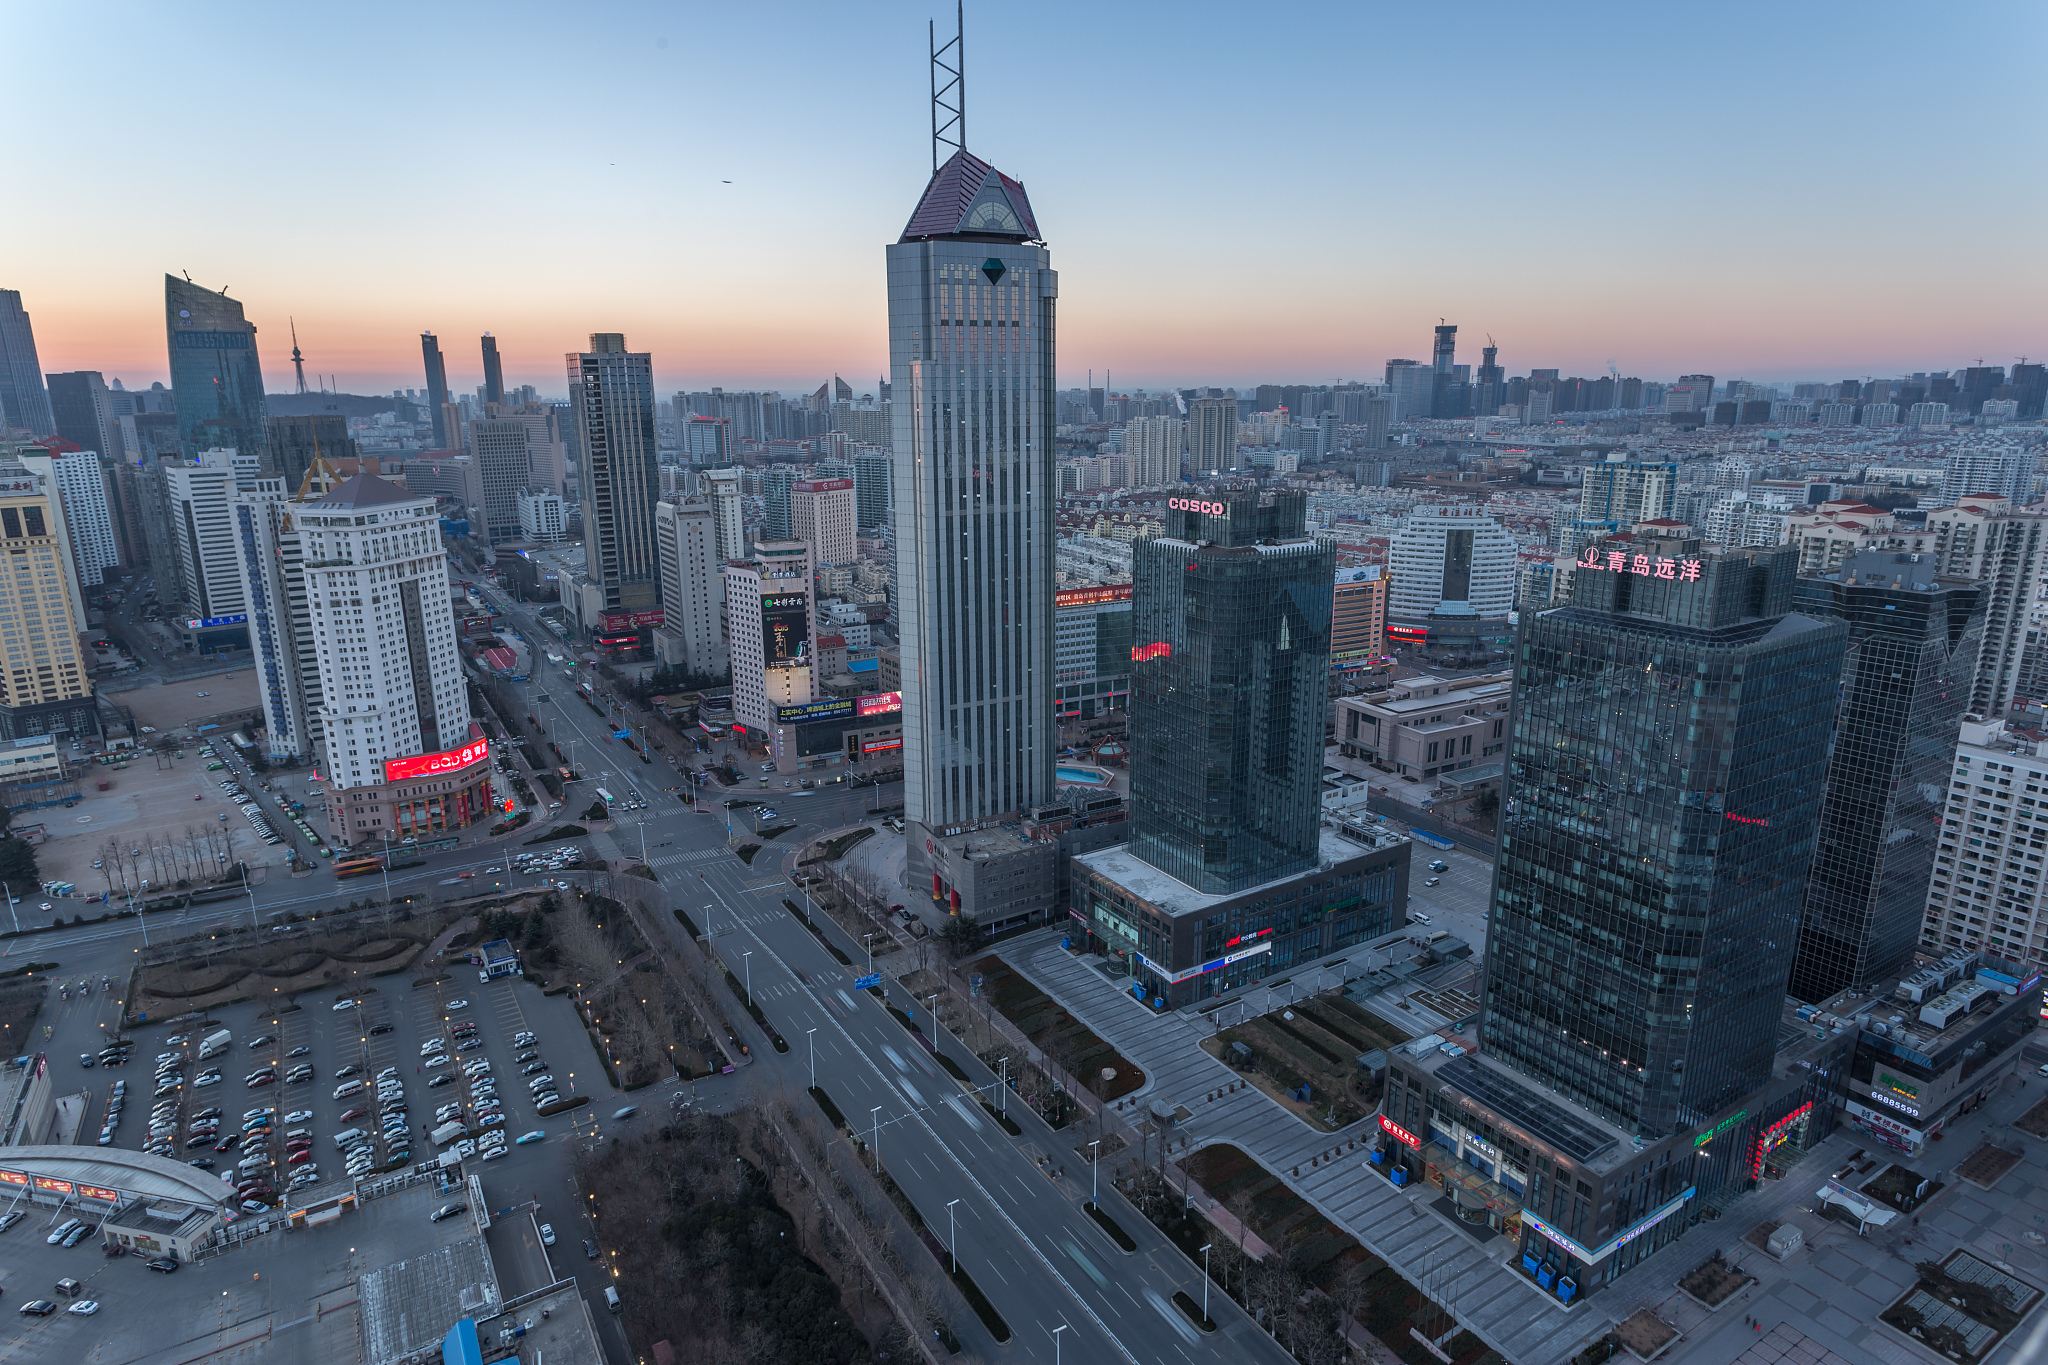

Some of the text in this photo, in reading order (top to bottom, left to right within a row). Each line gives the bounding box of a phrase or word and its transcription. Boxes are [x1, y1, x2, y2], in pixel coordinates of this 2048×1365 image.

[1169, 497, 1223, 515] COSCO
[1606, 551, 1701, 583] 青岛远洋
[1871, 1091, 1919, 1117] 66885599
